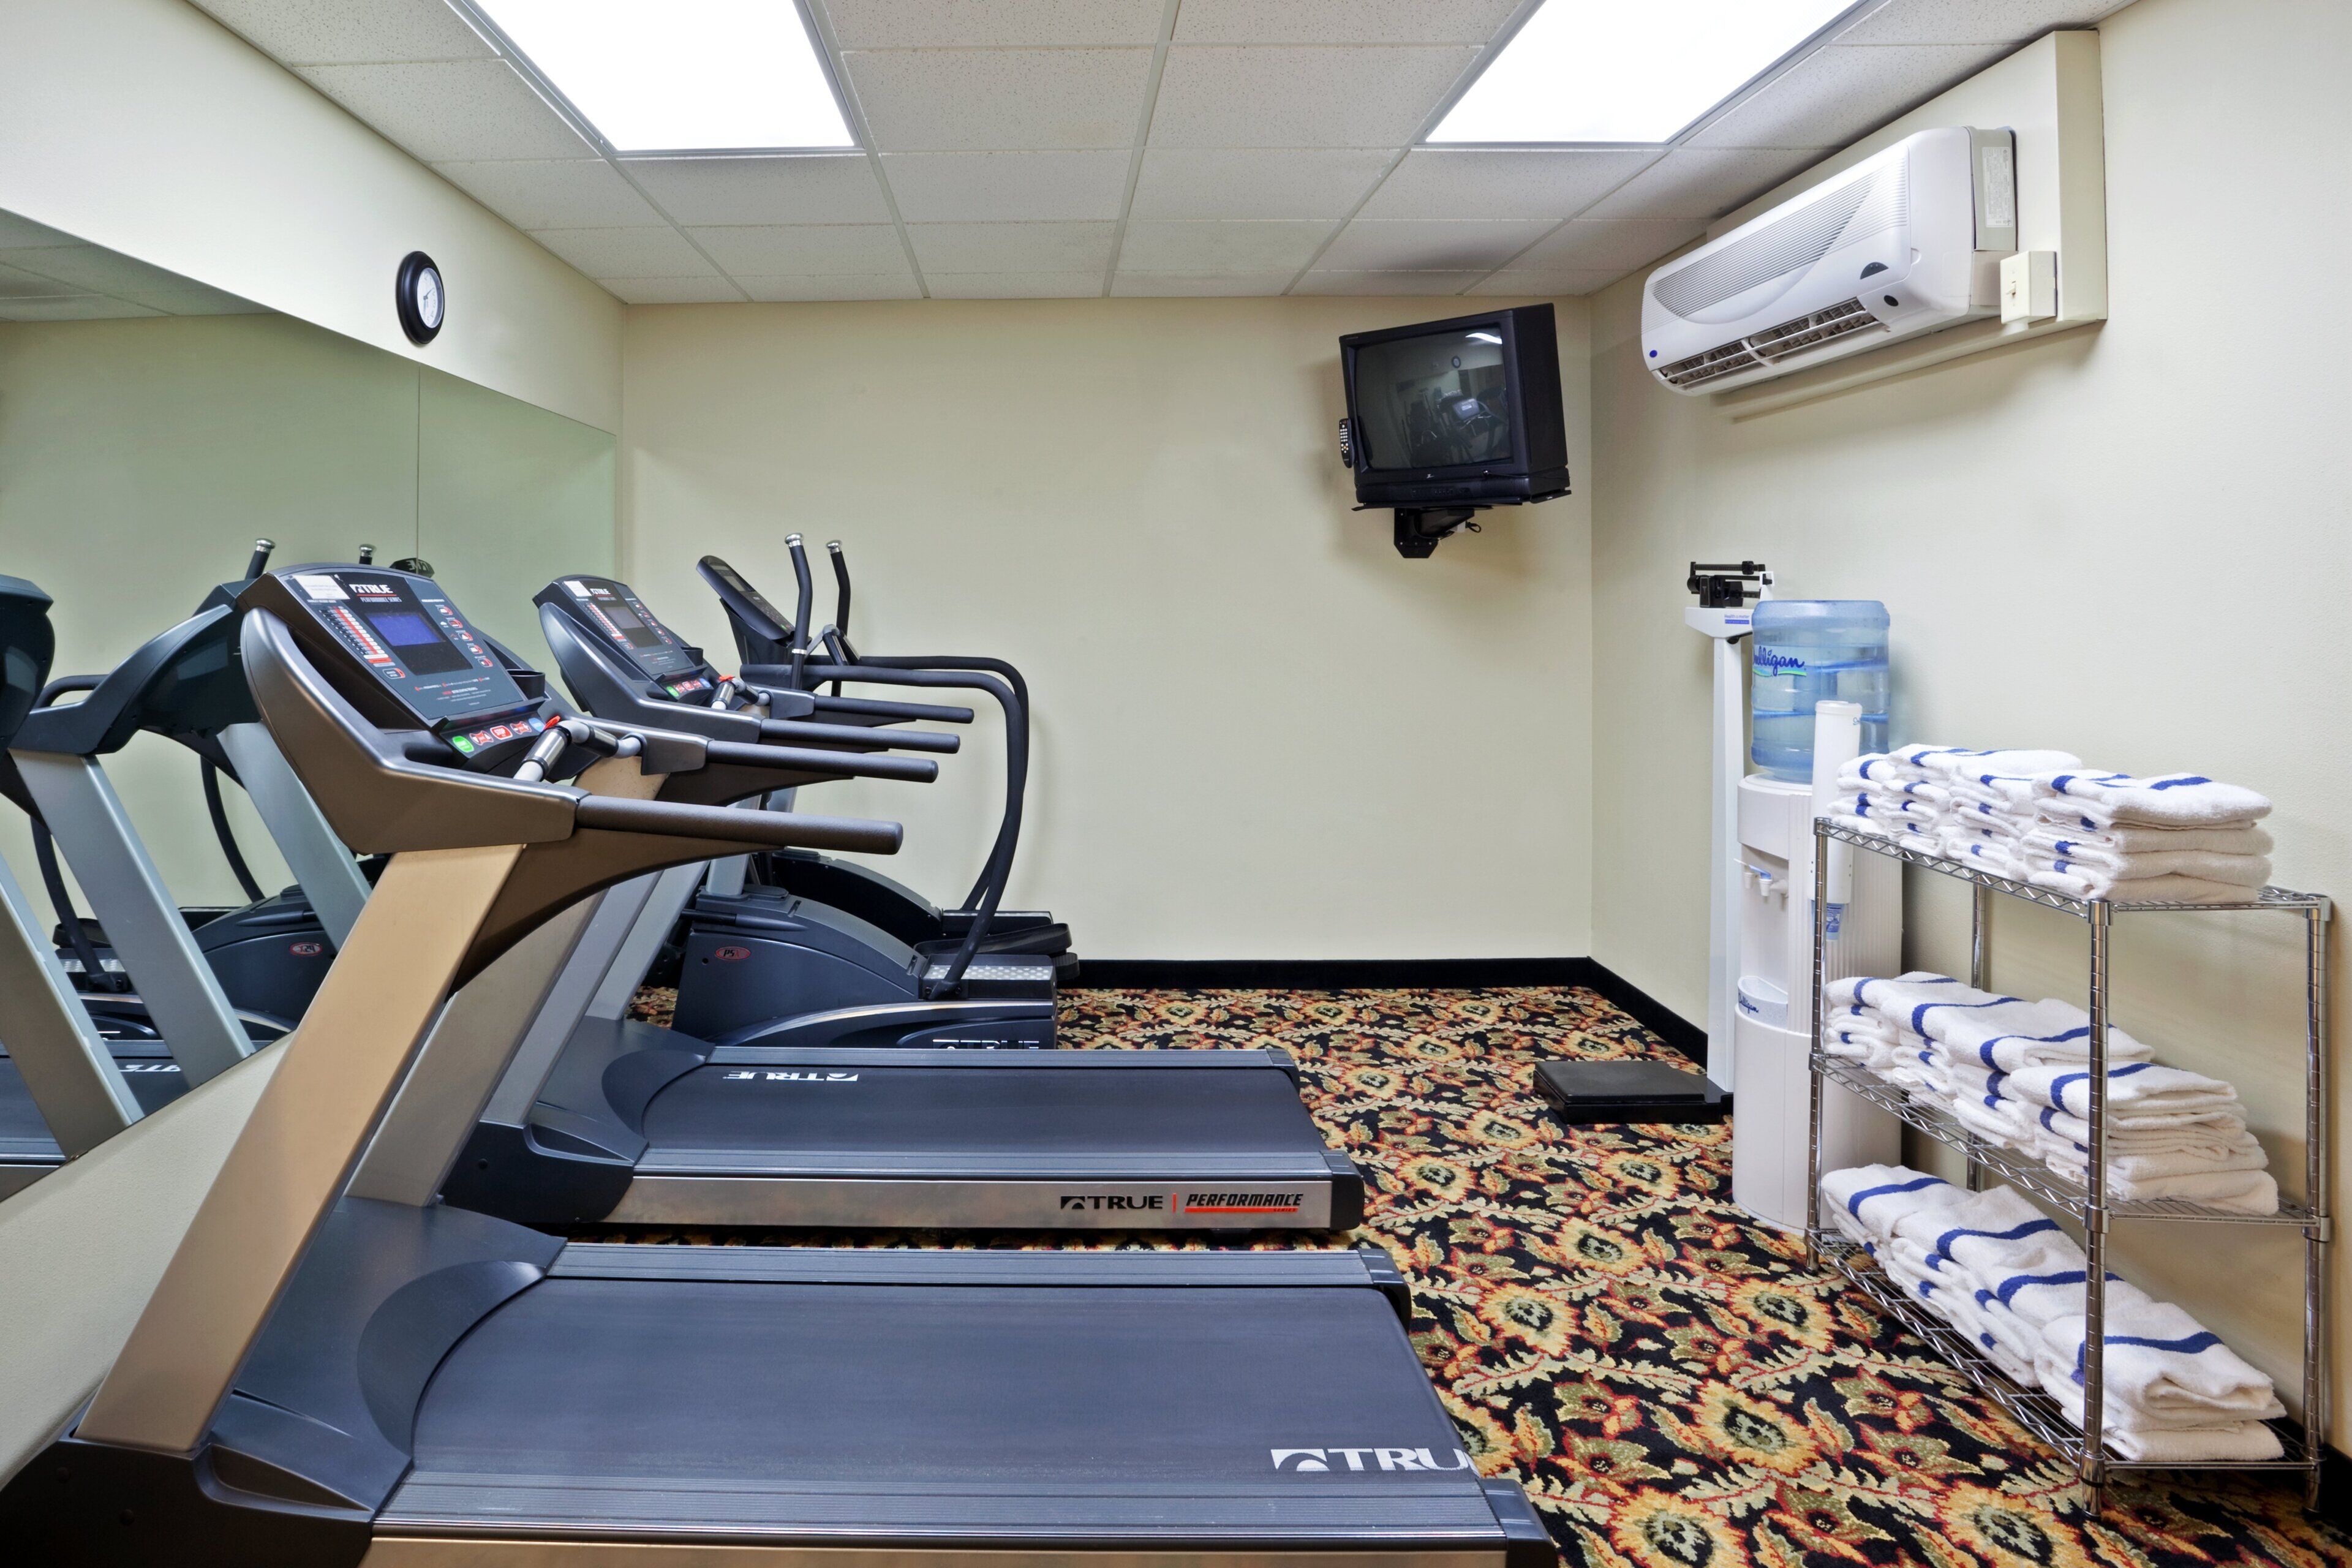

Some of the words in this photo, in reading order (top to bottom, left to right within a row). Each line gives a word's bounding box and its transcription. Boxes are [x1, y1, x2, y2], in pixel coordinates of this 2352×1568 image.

[361, 584, 393, 594] TRUE
[1754, 646, 1805, 676] ulligan
[726, 1071, 824, 1081] TRUE
[1087, 1196, 1163, 1210] TRUE
[1186, 1193, 1303, 1207] PERFORMANCE
